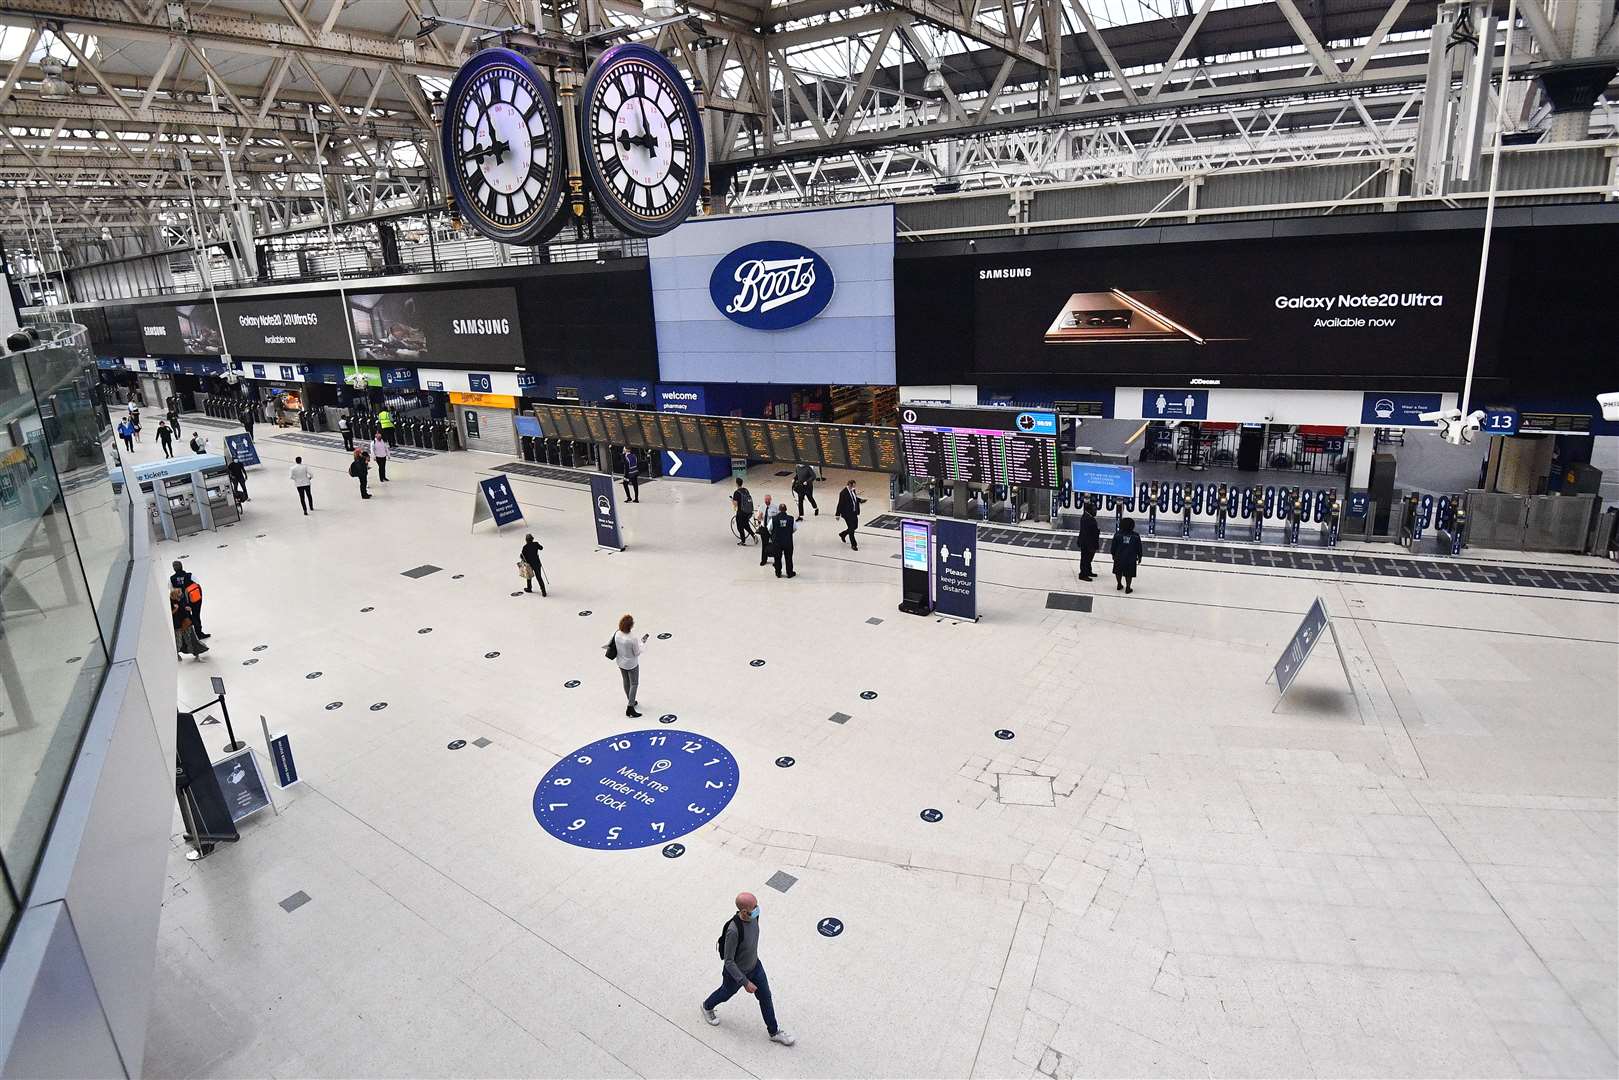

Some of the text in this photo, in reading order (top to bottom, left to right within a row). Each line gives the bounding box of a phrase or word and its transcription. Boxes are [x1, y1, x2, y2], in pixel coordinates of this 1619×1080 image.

[980, 268, 1032, 280] SAMSUNG
[726, 256, 816, 313] Boots
[1275, 293, 1443, 310] Galaxy Note20 Ultra
[239, 314, 260, 328] Galaxy
[260, 314, 282, 326] Note20
[453, 318, 510, 334] SAMSUNG
[1314, 317, 1396, 327] Available now
[144, 326, 166, 336] SAMSUNG
[264, 336, 285, 344] Available
[402, 370, 411, 378] 10
[527, 376, 536, 385] 11
[662, 391, 698, 400] welcome
[1491, 415, 1512, 429] 13
[1158, 431, 1170, 440] 12
[1328, 440, 1342, 450] 13
[144, 470, 168, 480] tickets
[946, 567, 968, 577] Please
[941, 576, 972, 587] keep your
[942, 584, 970, 595] distance
[609, 740, 631, 752] 10
[649, 736, 666, 747] 11
[681, 741, 702, 754] 12
[577, 756, 593, 765] 9
[703, 758, 720, 767] 1
[554, 778, 572, 786] 8
[617, 766, 669, 793] Meet me
[599, 777, 656, 805] under the
[705, 781, 723, 790] 2
[549, 802, 568, 811] 7
[595, 792, 628, 812] clock
[687, 802, 705, 814] 3
[568, 818, 587, 831] 6
[651, 822, 665, 833] 4
[607, 827, 622, 840] 5
